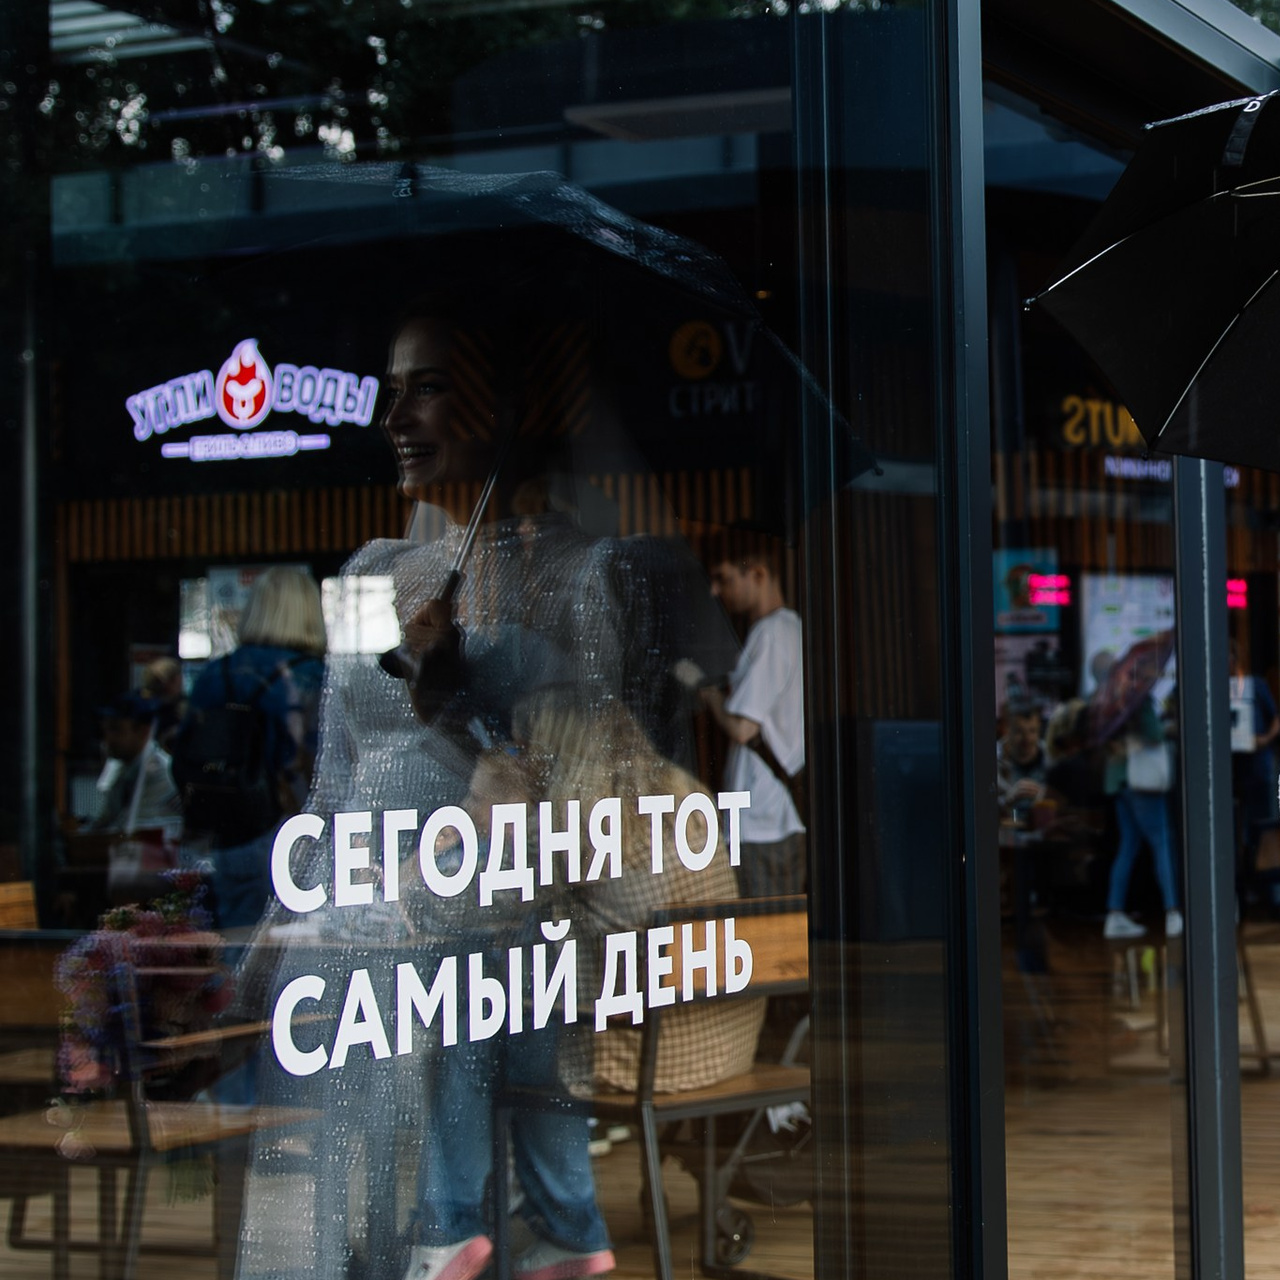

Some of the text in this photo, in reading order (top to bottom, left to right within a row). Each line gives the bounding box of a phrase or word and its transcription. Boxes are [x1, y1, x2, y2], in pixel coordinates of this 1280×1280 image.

[126, 363, 380, 442] УГЛИ ВОДЫ
[270, 790, 751, 913] СЕГОДНЯ ТОТ
[271, 917, 754, 1077] САМЫЙ ДЕНЬ
